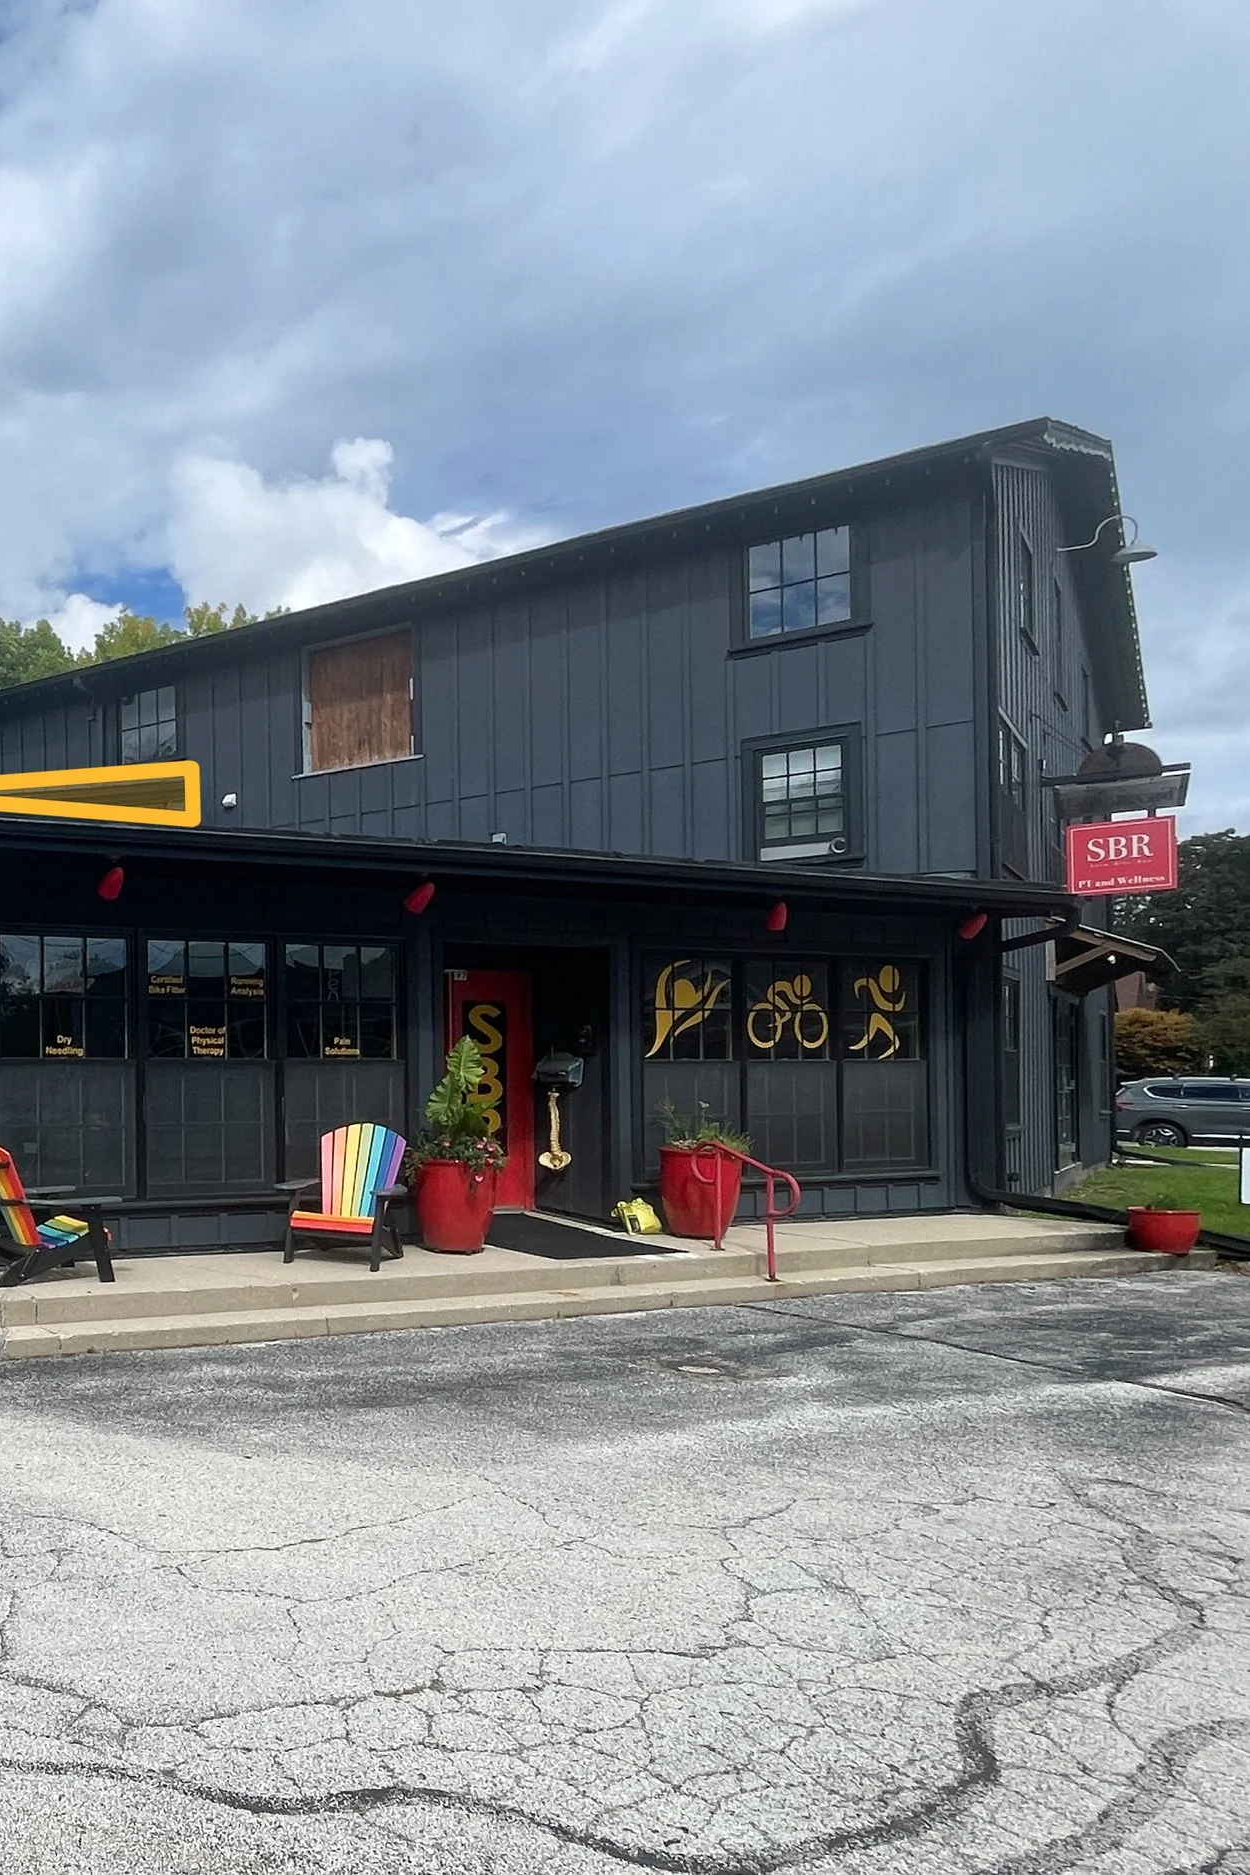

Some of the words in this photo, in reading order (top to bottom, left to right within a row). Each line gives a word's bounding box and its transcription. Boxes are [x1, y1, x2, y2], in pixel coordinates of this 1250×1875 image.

[1087, 833, 1154, 862] SBR
[1095, 878, 1114, 887] and
[1117, 875, 1165, 885] Wellness
[230, 977, 263, 987] Running
[230, 987, 265, 997] Analysis
[189, 1026, 216, 1035] Doctor
[217, 1026, 227, 1035] of
[56, 1035, 73, 1045] Dry
[191, 1036, 225, 1046] Physical
[333, 1036, 351, 1045] Pain
[45, 1046, 84, 1057] Needling
[192, 1046, 224, 1057] Therapy
[324, 1046, 360, 1056] Solutions
